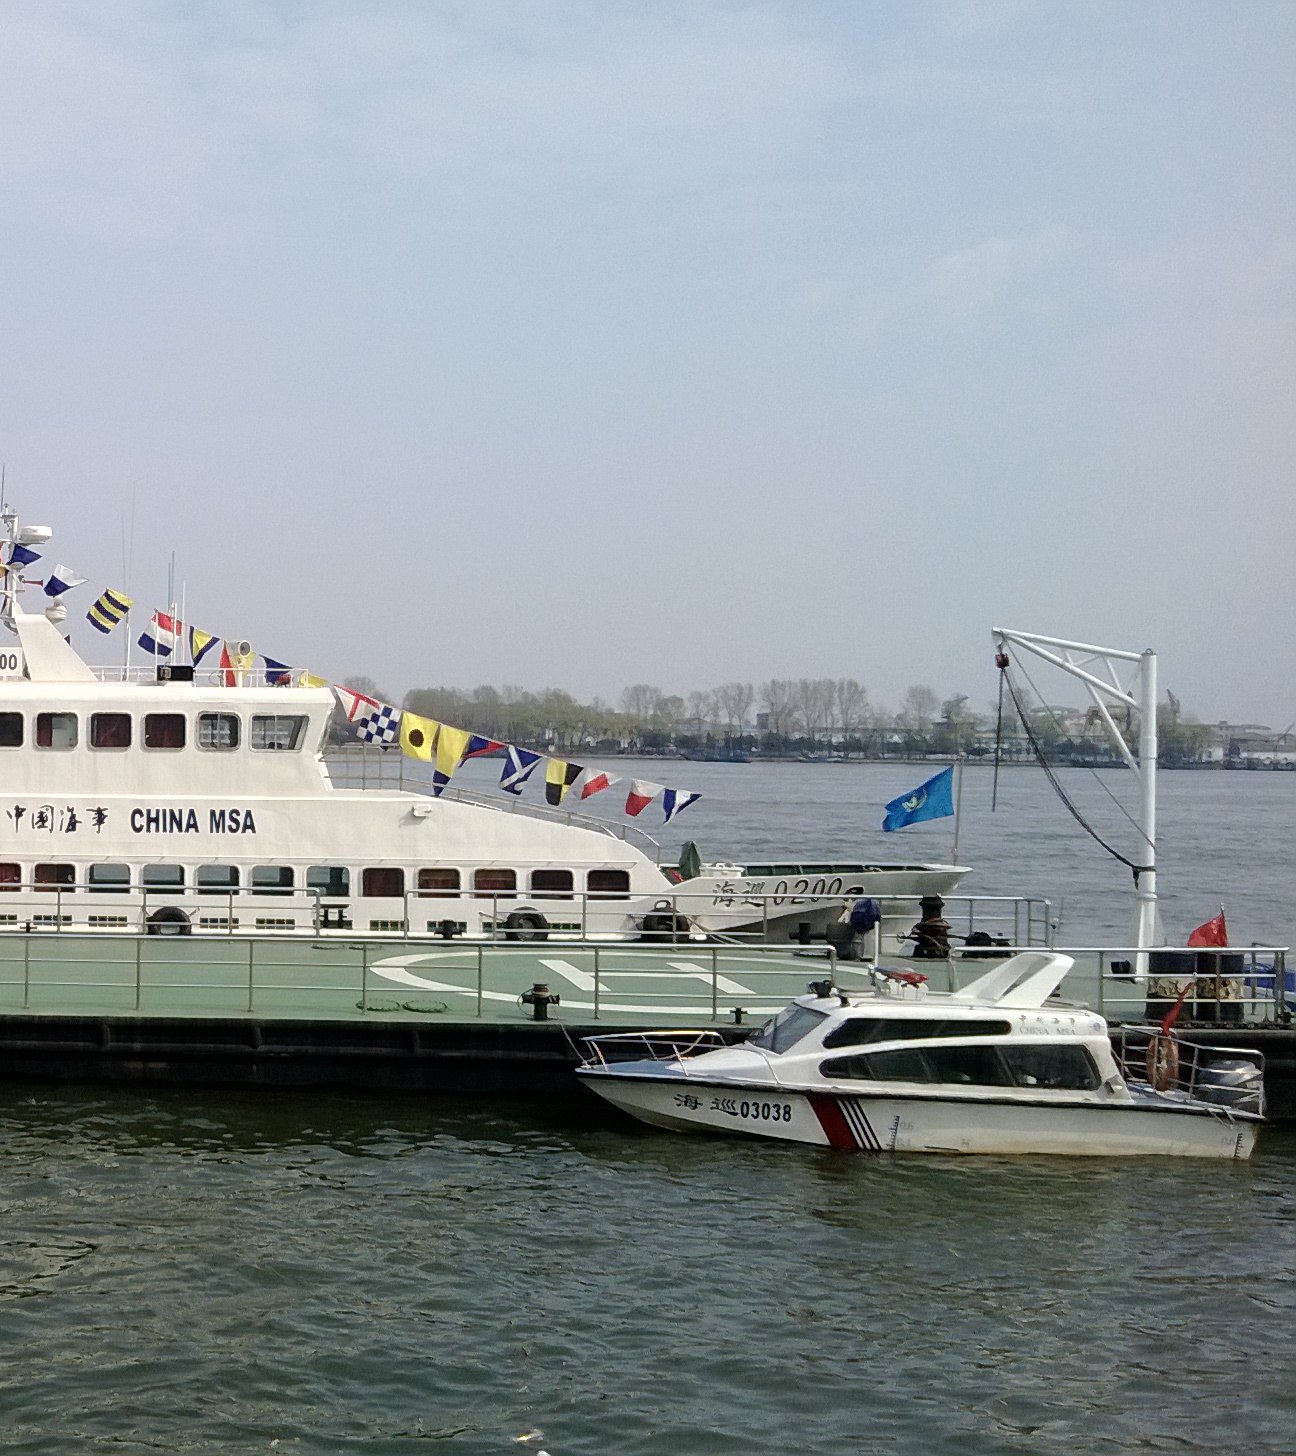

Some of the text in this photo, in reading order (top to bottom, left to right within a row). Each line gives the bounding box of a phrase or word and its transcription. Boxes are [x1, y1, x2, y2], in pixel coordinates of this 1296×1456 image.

[130, 808, 200, 833] CHINA
[209, 809, 256, 834] MSA
[712, 877, 843, 908] 海巡 0200
[740, 1101, 792, 1122] 03038
